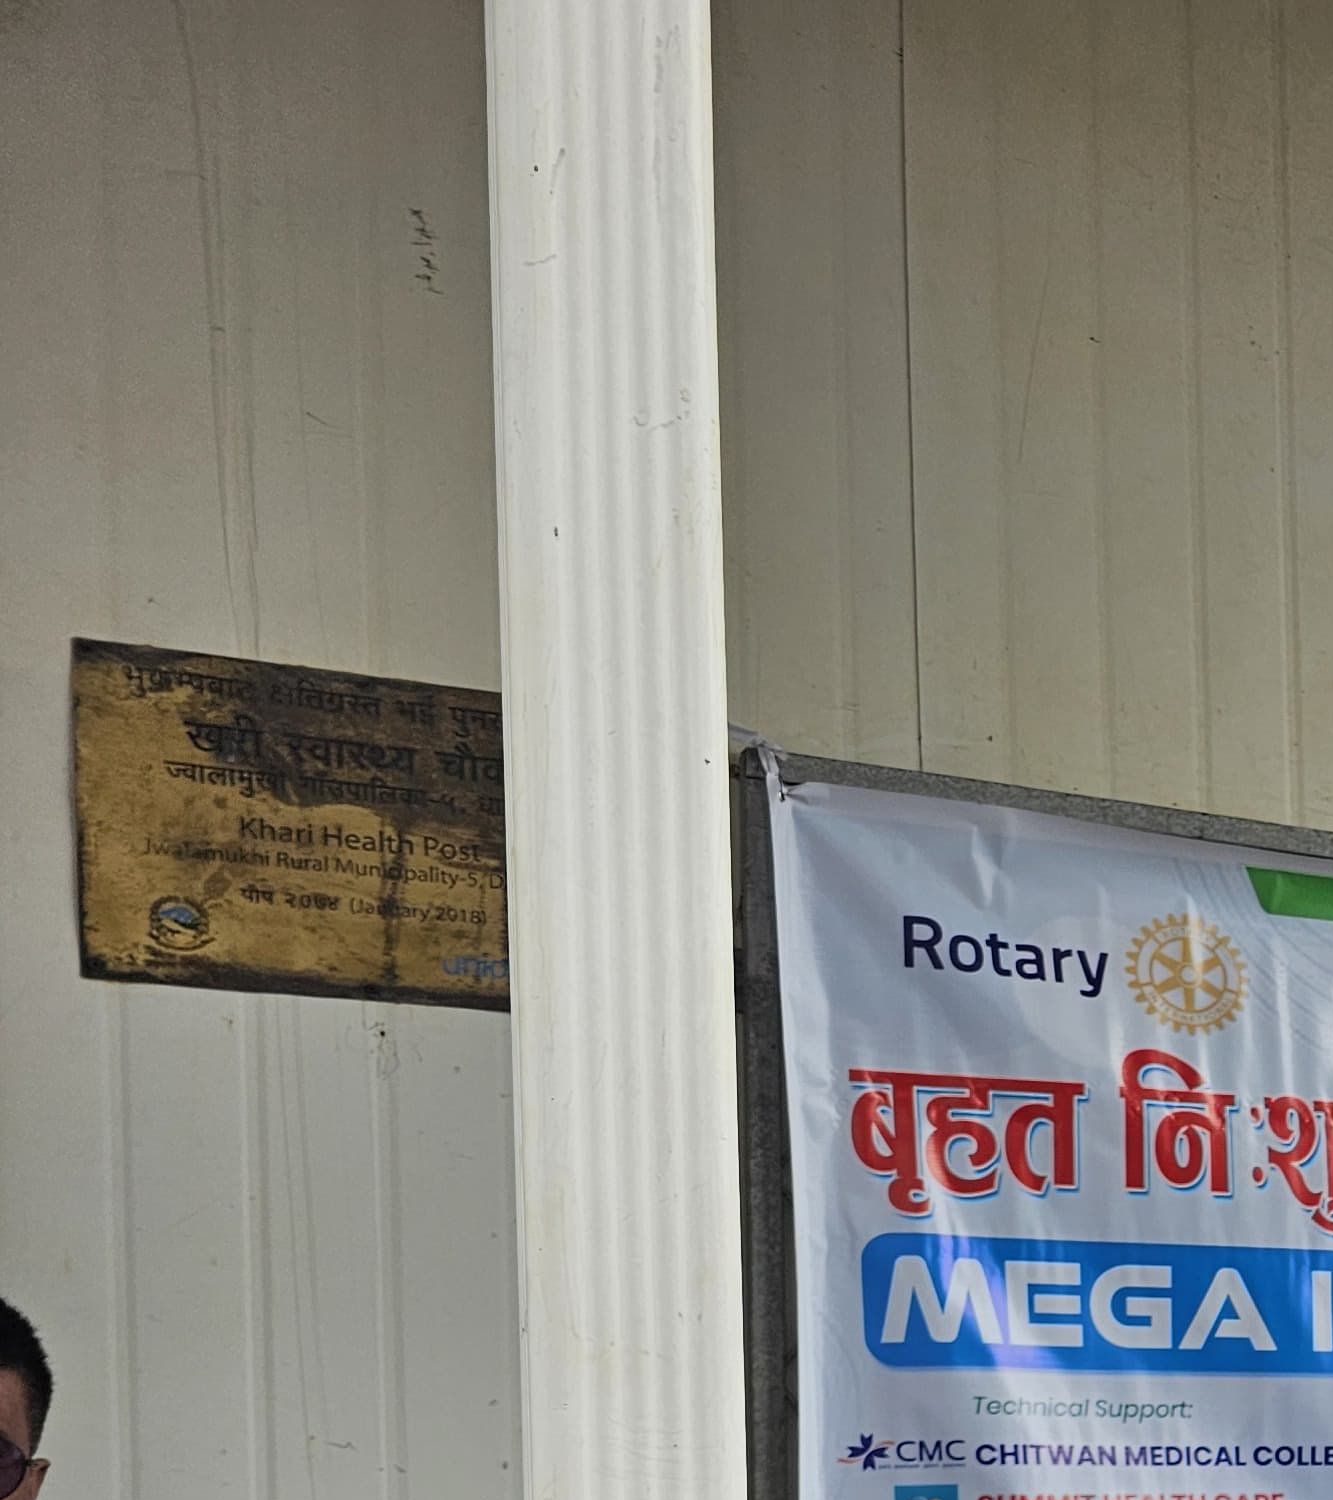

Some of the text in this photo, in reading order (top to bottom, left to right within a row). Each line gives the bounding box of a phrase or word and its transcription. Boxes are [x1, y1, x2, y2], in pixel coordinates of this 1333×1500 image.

[239, 816, 481, 863] Khari Health Post
[276, 851, 329, 872] Rural
[903, 914, 1109, 998] Rotary
[848, 1068, 1088, 1218] बृहत
[880, 1254, 1279, 1352] MEGA
[973, 1395, 1193, 1424] Technical Support:
[896, 1439, 966, 1462] CMC
[975, 1443, 1117, 1466] CHITWAN
[1124, 1445, 1247, 1467] MEDICAL
